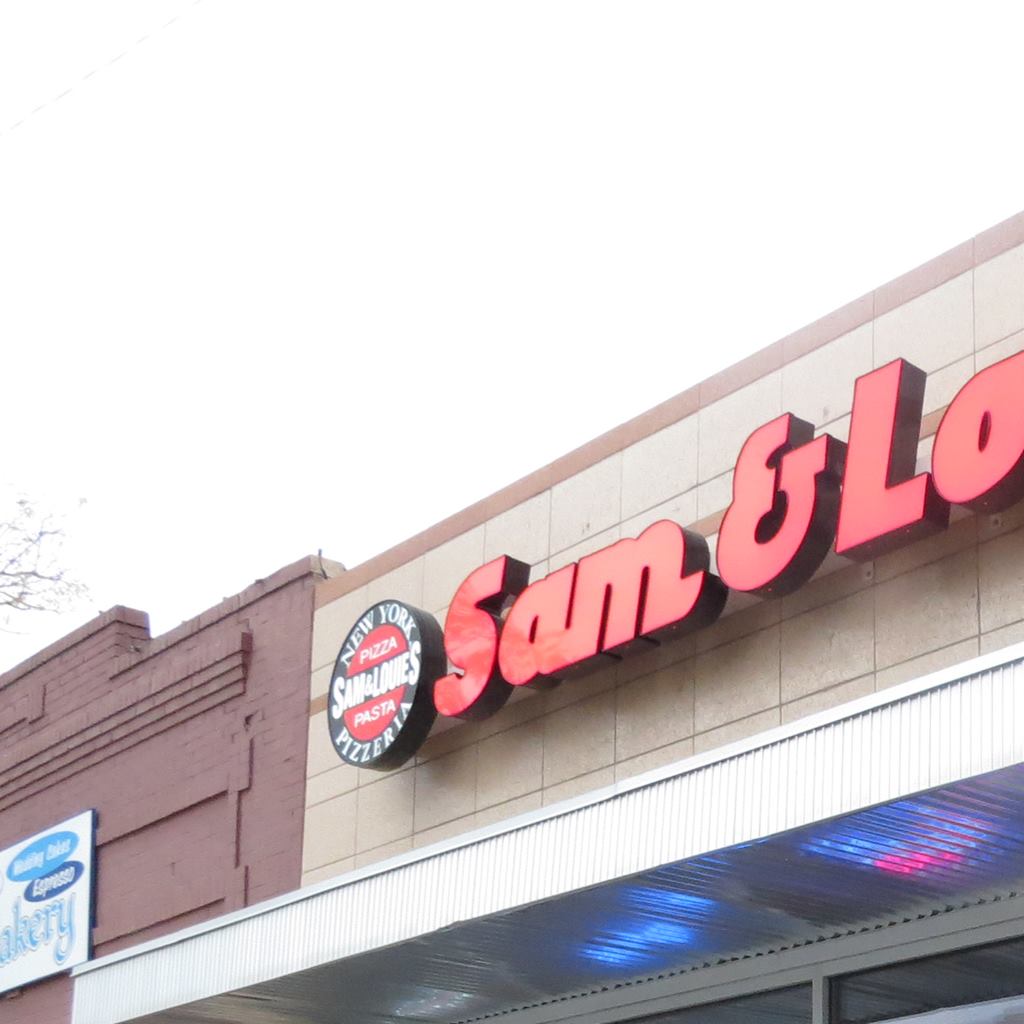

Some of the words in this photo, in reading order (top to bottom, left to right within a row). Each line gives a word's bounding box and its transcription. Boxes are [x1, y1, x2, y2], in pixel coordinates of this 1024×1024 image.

[434, 520, 709, 718] Sam
[716, 411, 836, 593] &
[341, 610, 375, 666] NEW
[379, 602, 418, 643] YORK
[359, 636, 397, 665] PIZZA
[335, 702, 413, 762] PIZZERIA
[354, 699, 397, 728] PASTA
